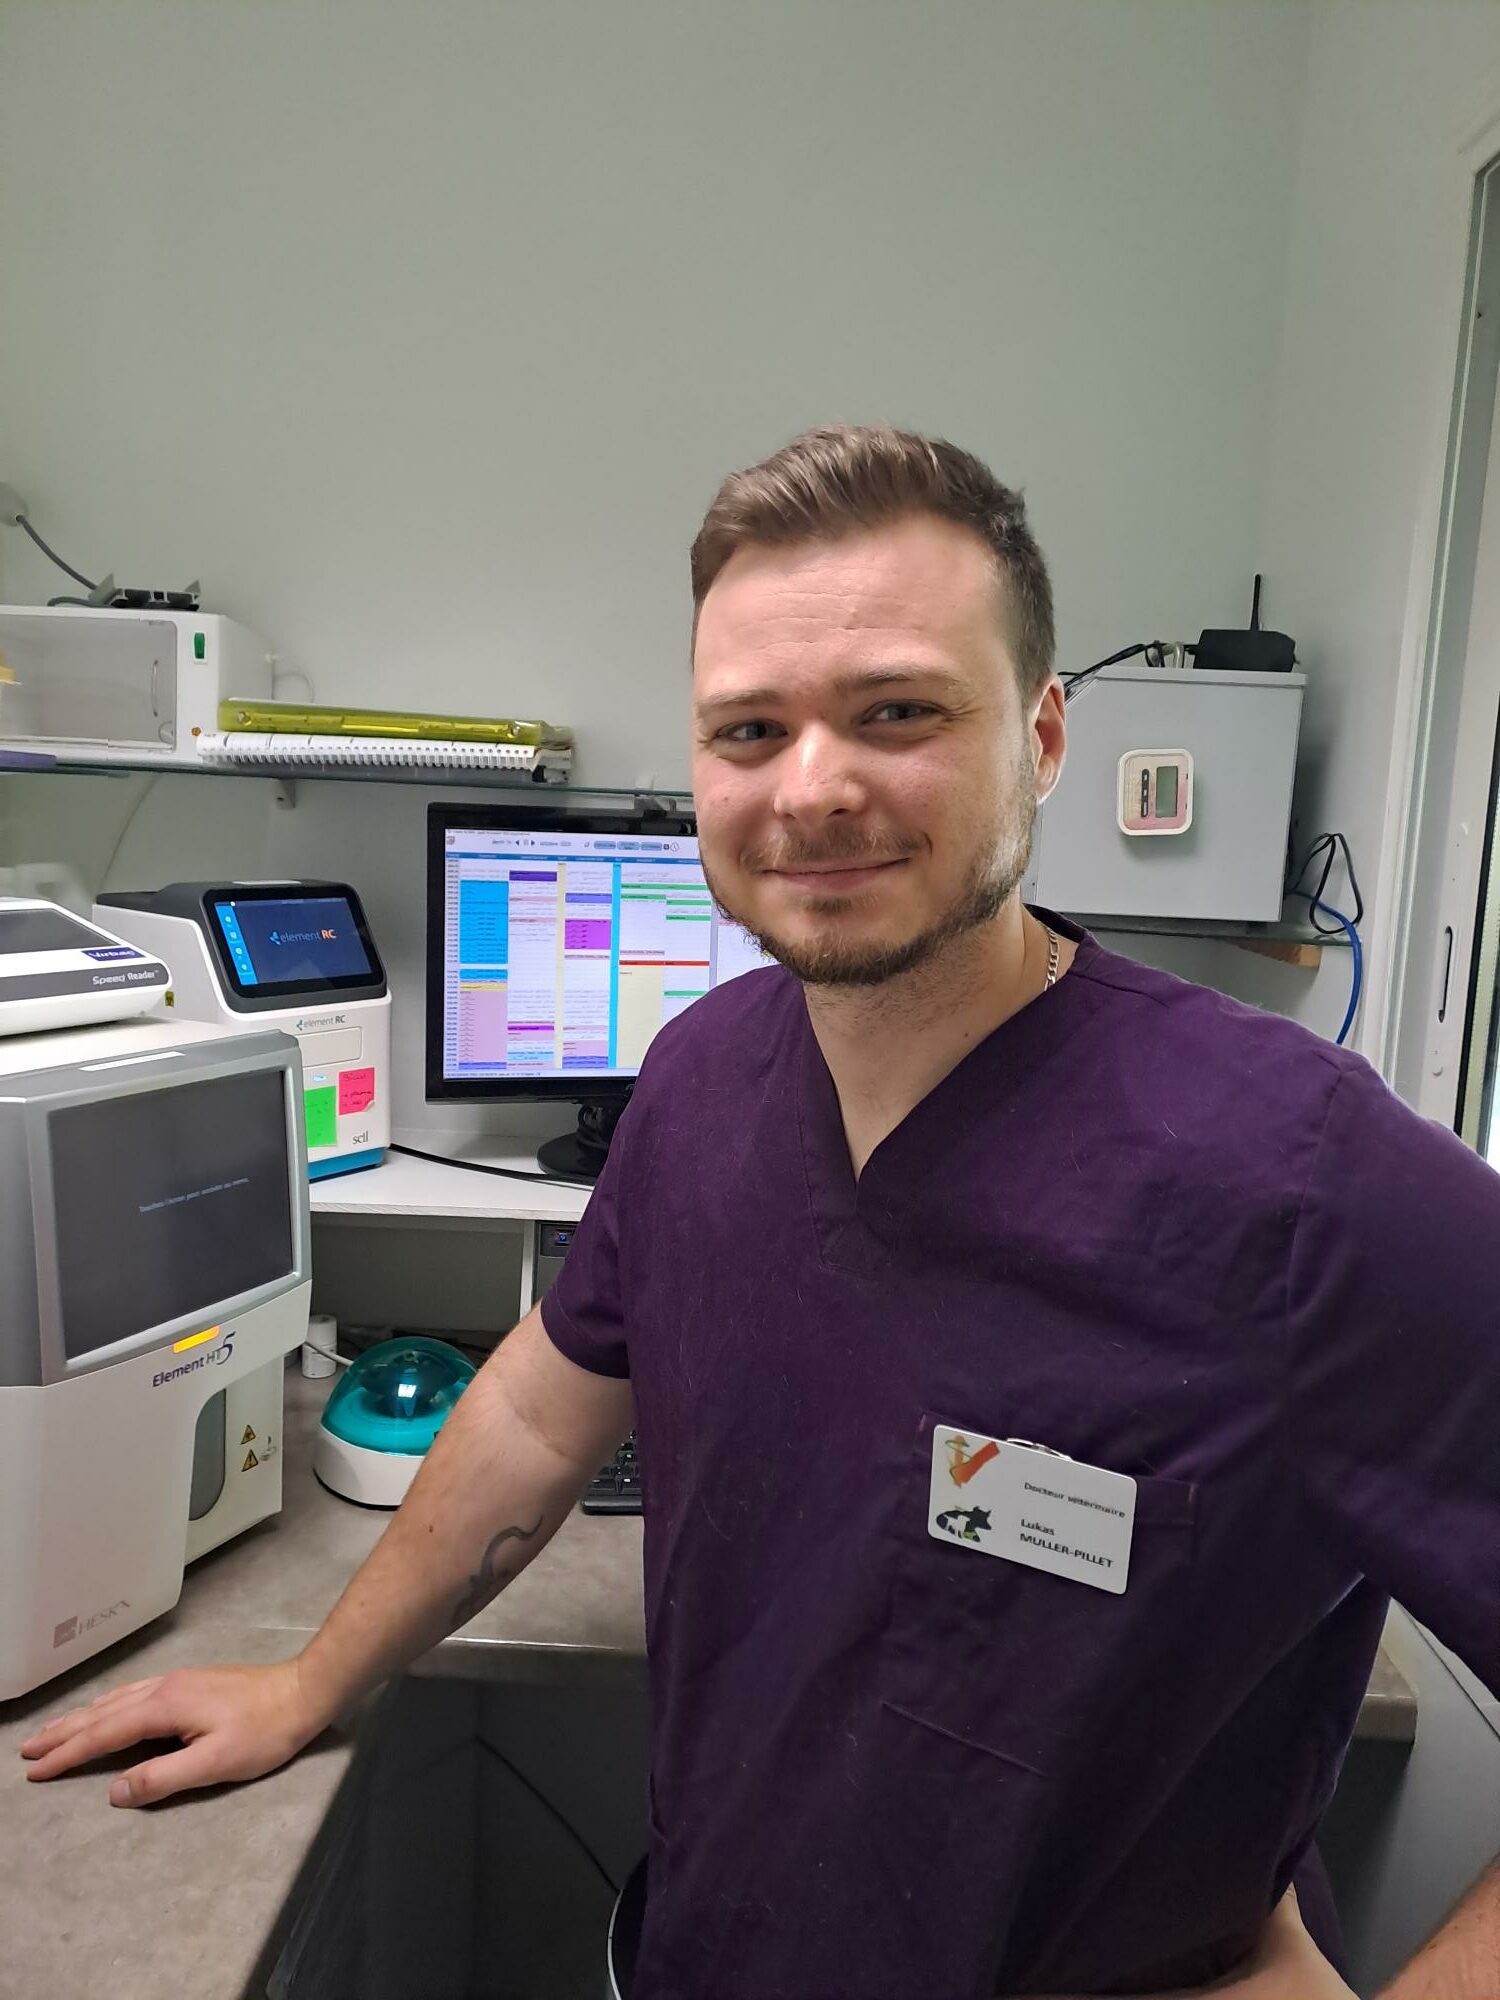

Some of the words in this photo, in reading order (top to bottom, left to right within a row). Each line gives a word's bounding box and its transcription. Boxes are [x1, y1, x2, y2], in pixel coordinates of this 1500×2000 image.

[280, 930, 320, 943] element
[320, 928, 337, 940] RC
[92, 974, 125, 985] Speed
[304, 1016, 334, 1028] element
[335, 1015, 346, 1024] RC
[152, 1357, 205, 1388] Element
[1024, 1482, 1064, 1500] Docteur
[1020, 1519, 1056, 1536] Lukas
[1020, 1533, 1114, 1569] MULLER-PILLET
